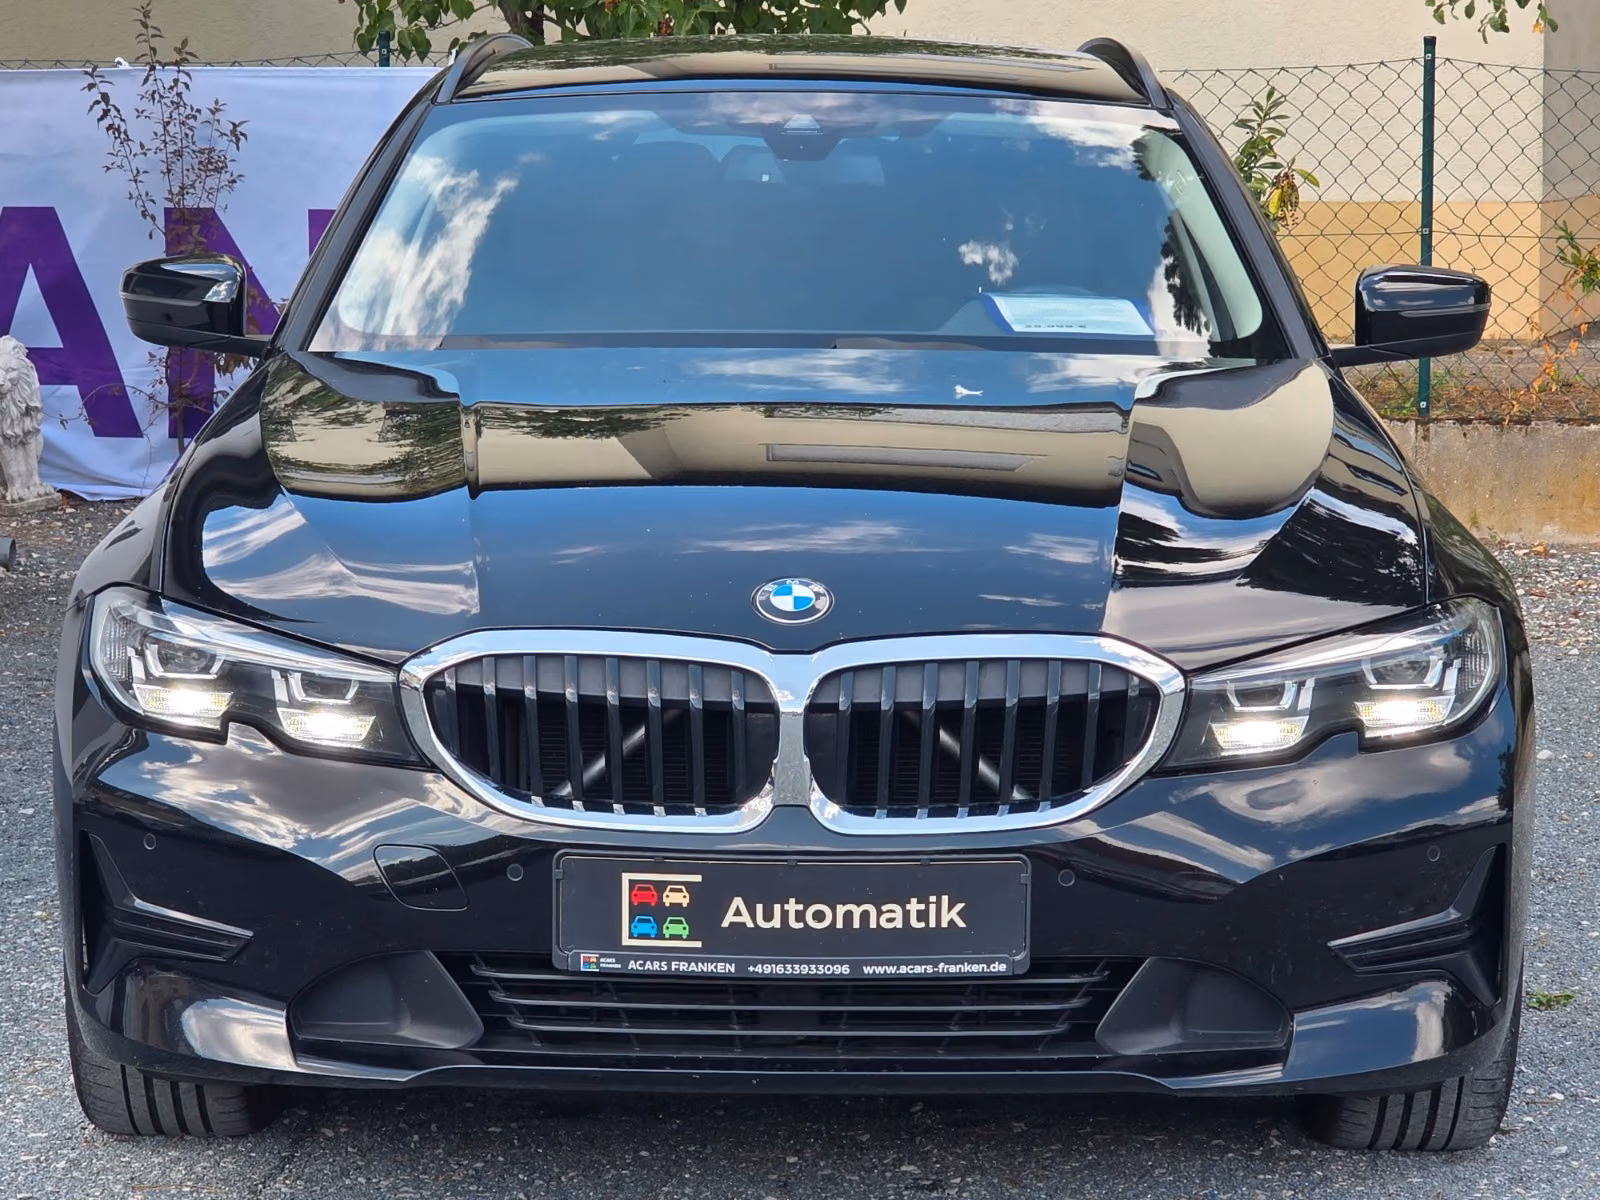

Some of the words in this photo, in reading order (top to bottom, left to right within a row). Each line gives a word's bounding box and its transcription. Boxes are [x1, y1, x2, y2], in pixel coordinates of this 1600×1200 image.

[721, 895, 967, 929] Automatik
[628, 960, 668, 971] ACARS
[671, 962, 735, 973] FRANKEN
[748, 964, 850, 975] +491633933096
[863, 962, 1007, 975] www.acars-franken.de
